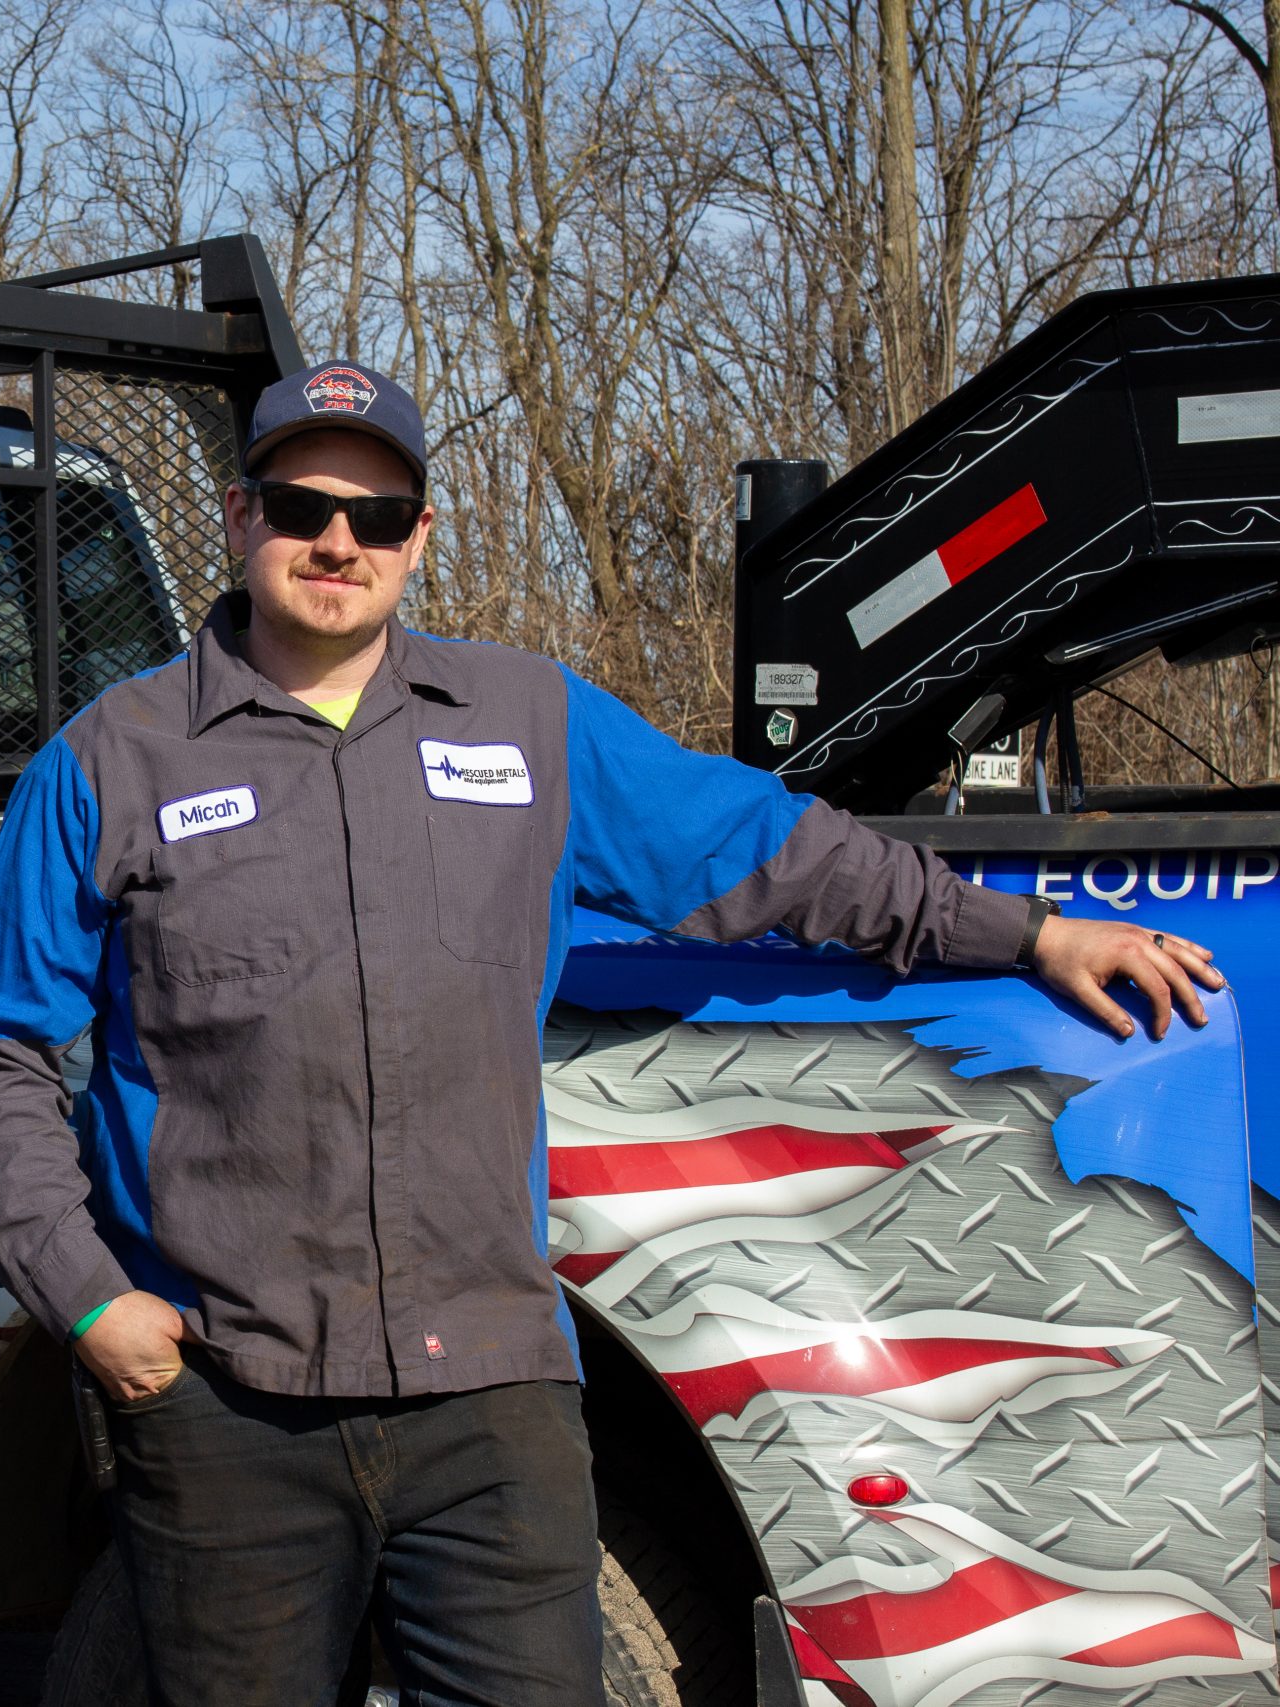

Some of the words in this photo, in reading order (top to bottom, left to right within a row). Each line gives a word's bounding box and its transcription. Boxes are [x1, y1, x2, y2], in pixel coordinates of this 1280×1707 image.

[769, 673, 804, 685] 189327
[461, 768, 494, 778] RESCUED
[495, 768, 526, 778] METALS
[991, 761, 1017, 781] LANE
[475, 777, 508, 786] equipment
[179, 798, 239, 828] Micah
[1034, 851, 1279, 911] EQUIP
